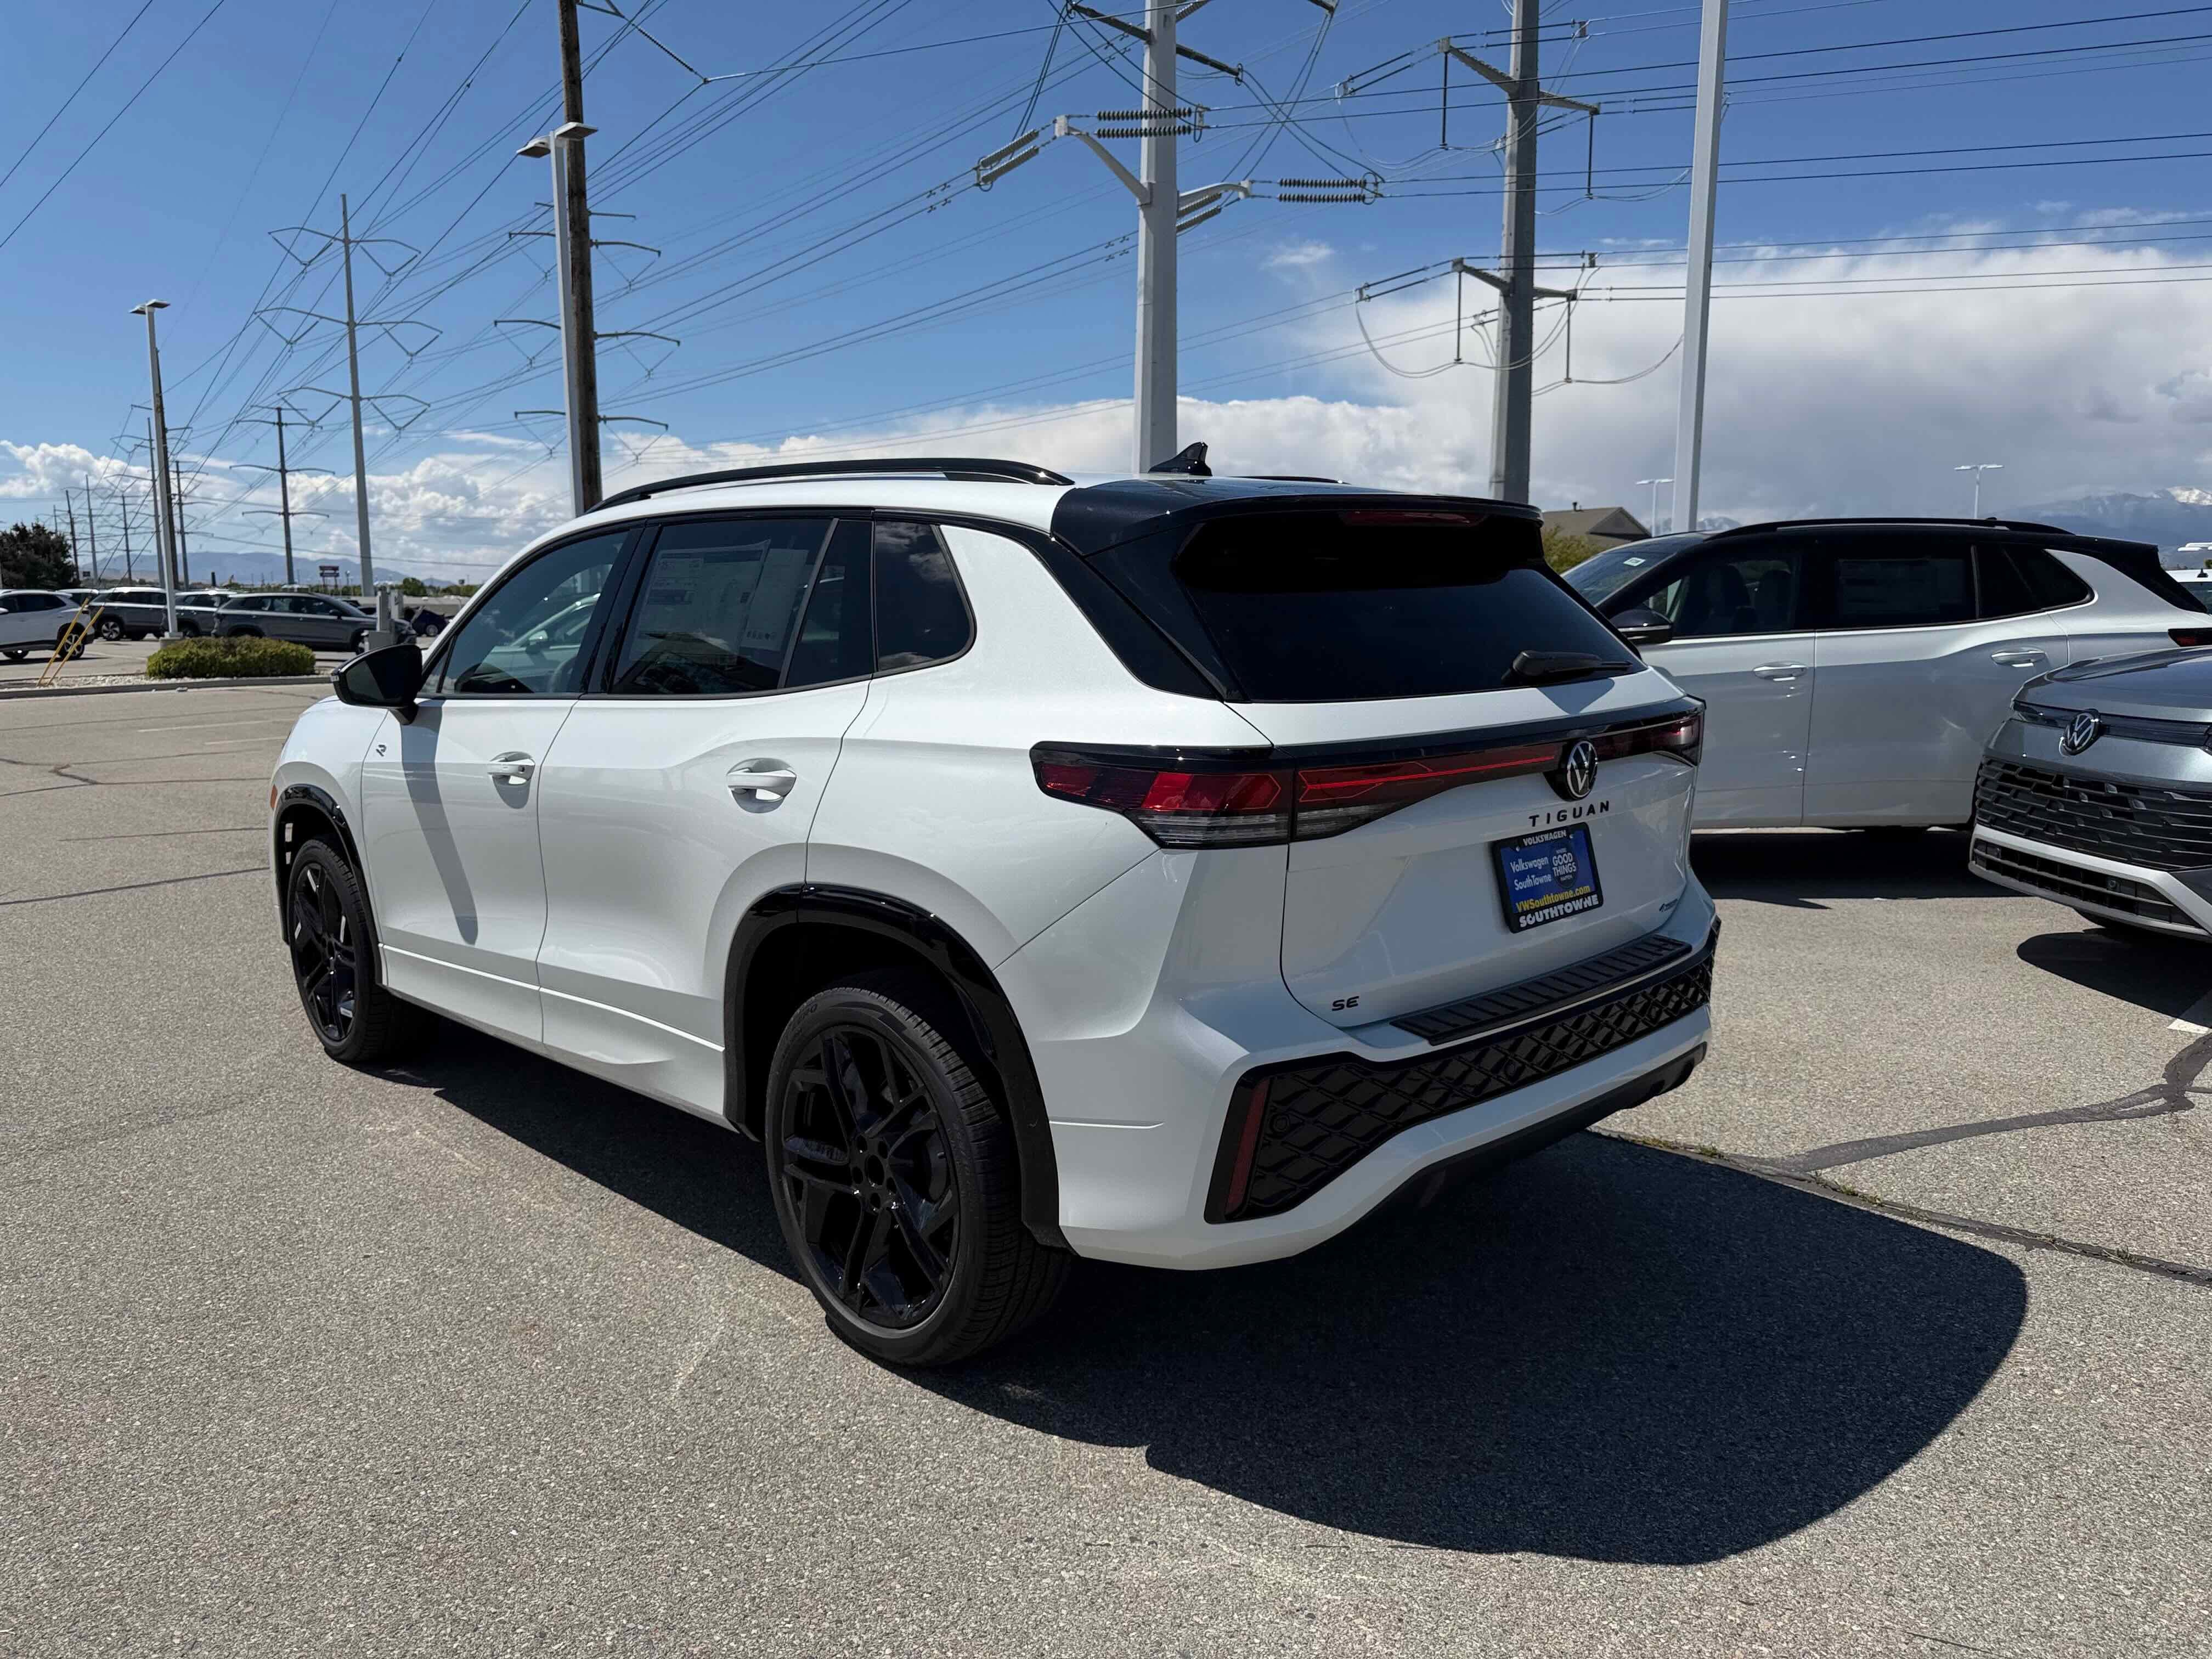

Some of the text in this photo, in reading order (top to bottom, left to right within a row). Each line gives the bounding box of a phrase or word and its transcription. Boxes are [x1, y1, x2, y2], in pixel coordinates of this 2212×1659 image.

[1529, 800, 1609, 827] TIGUAN
[1523, 830, 1567, 847] VOLKSWAGEN
[1510, 856, 1549, 873] Volkswagen
[1552, 853, 1573, 866] GOOD
[1552, 862, 1577, 877] THINGS
[1514, 873, 1552, 891] SouthTowne
[1516, 885, 1590, 912] VWSouthtowne.com
[1519, 894, 1599, 928] SOUTHTOWNE
[1331, 996, 1359, 1012] SE
